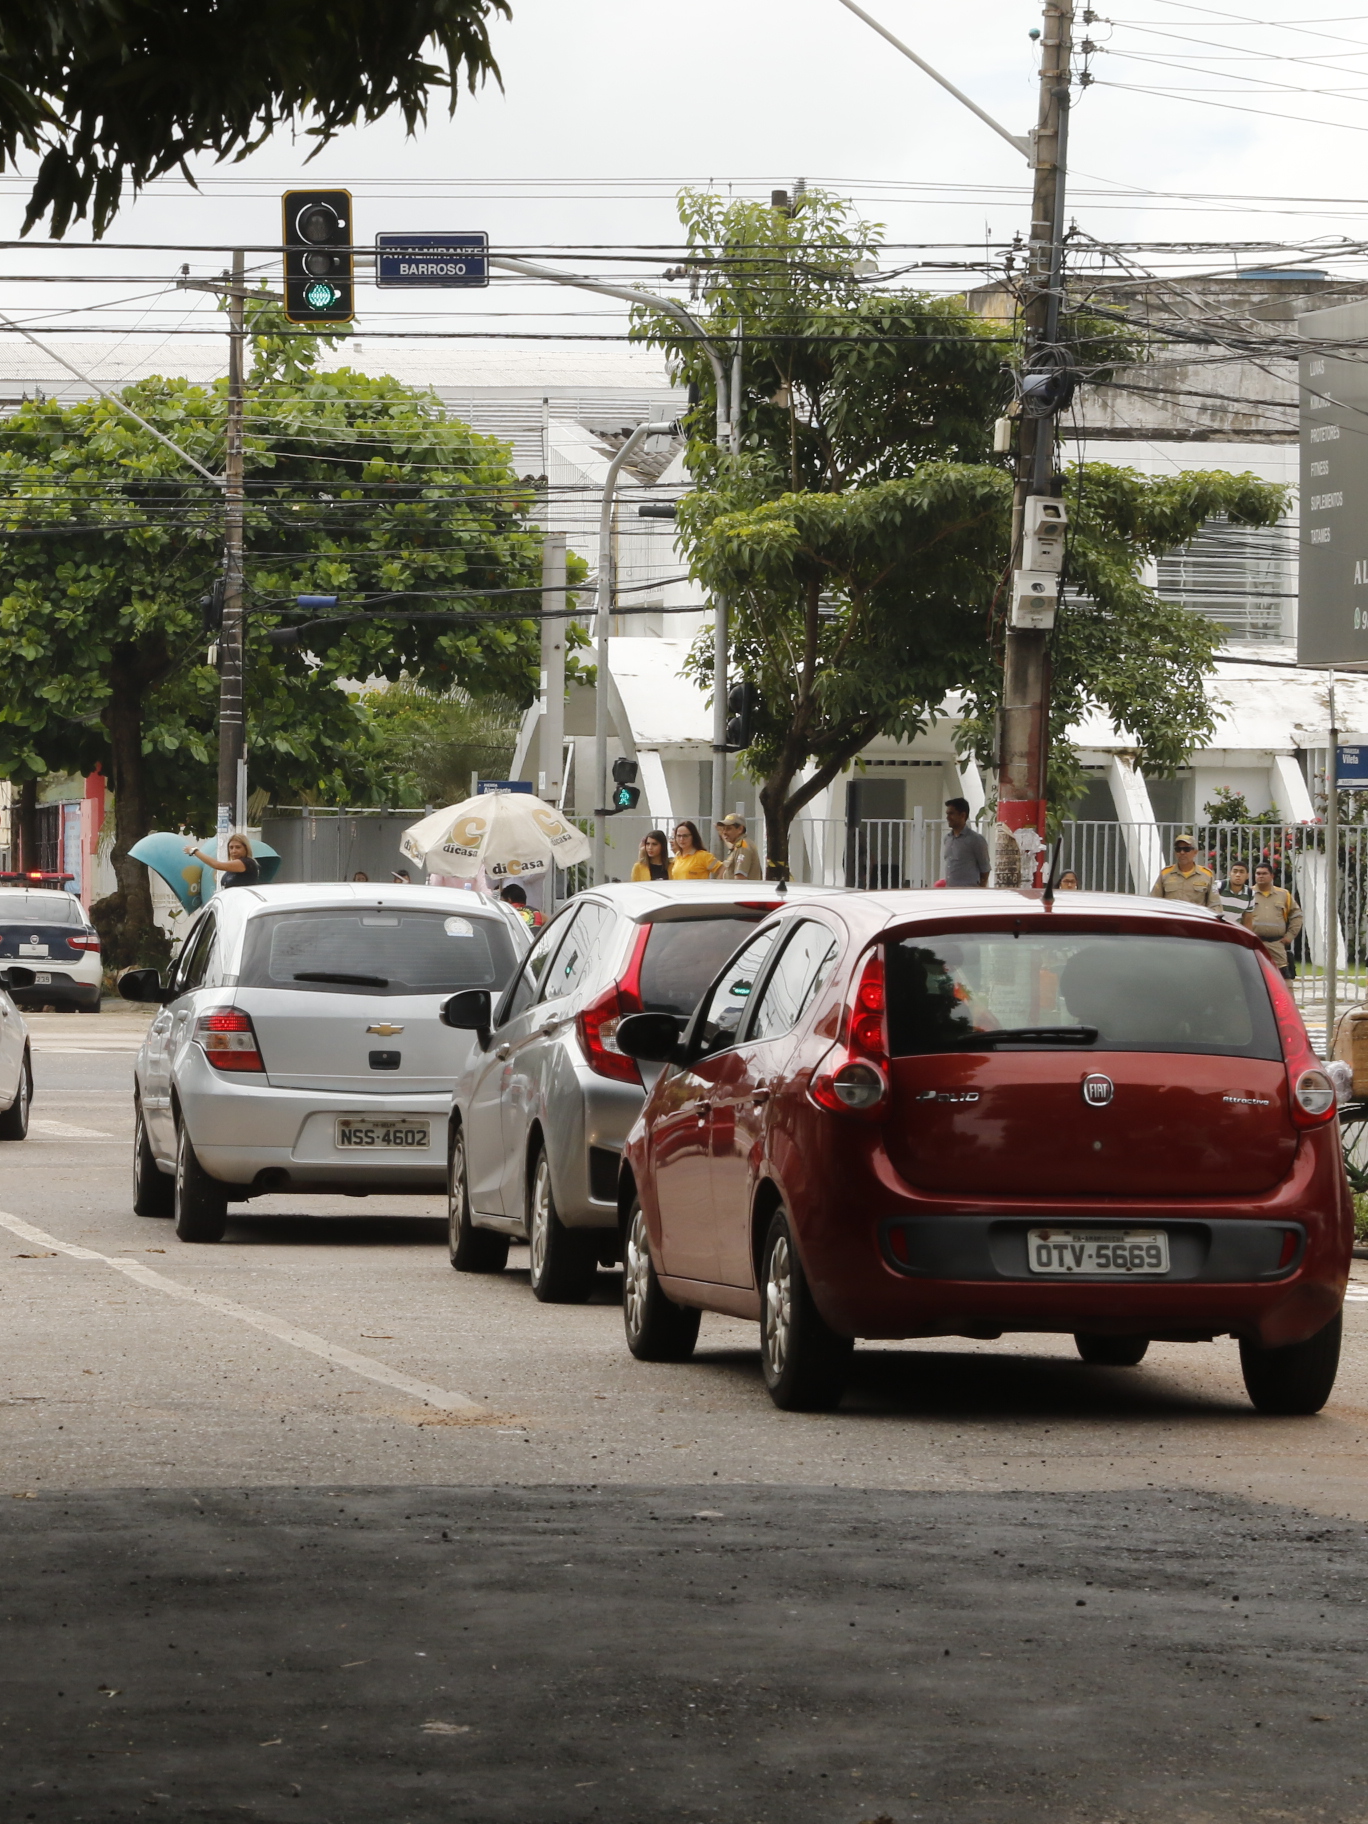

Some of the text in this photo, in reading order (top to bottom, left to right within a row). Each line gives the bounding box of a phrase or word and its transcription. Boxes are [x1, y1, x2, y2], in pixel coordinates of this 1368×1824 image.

[400, 263, 466, 275] BARROSO
[1310, 460, 1329, 477] FITNESS
[1310, 491, 1343, 511] SUPLEMENTOS
[1310, 527, 1331, 544] TATAMES
[549, 833, 572, 847] dicasa
[442, 843, 478, 858] dicasa
[916, 1090, 980, 1102] PALIO
[1089, 1083, 1108, 1099] FIAT
[1222, 1096, 1270, 1106] Attractive
